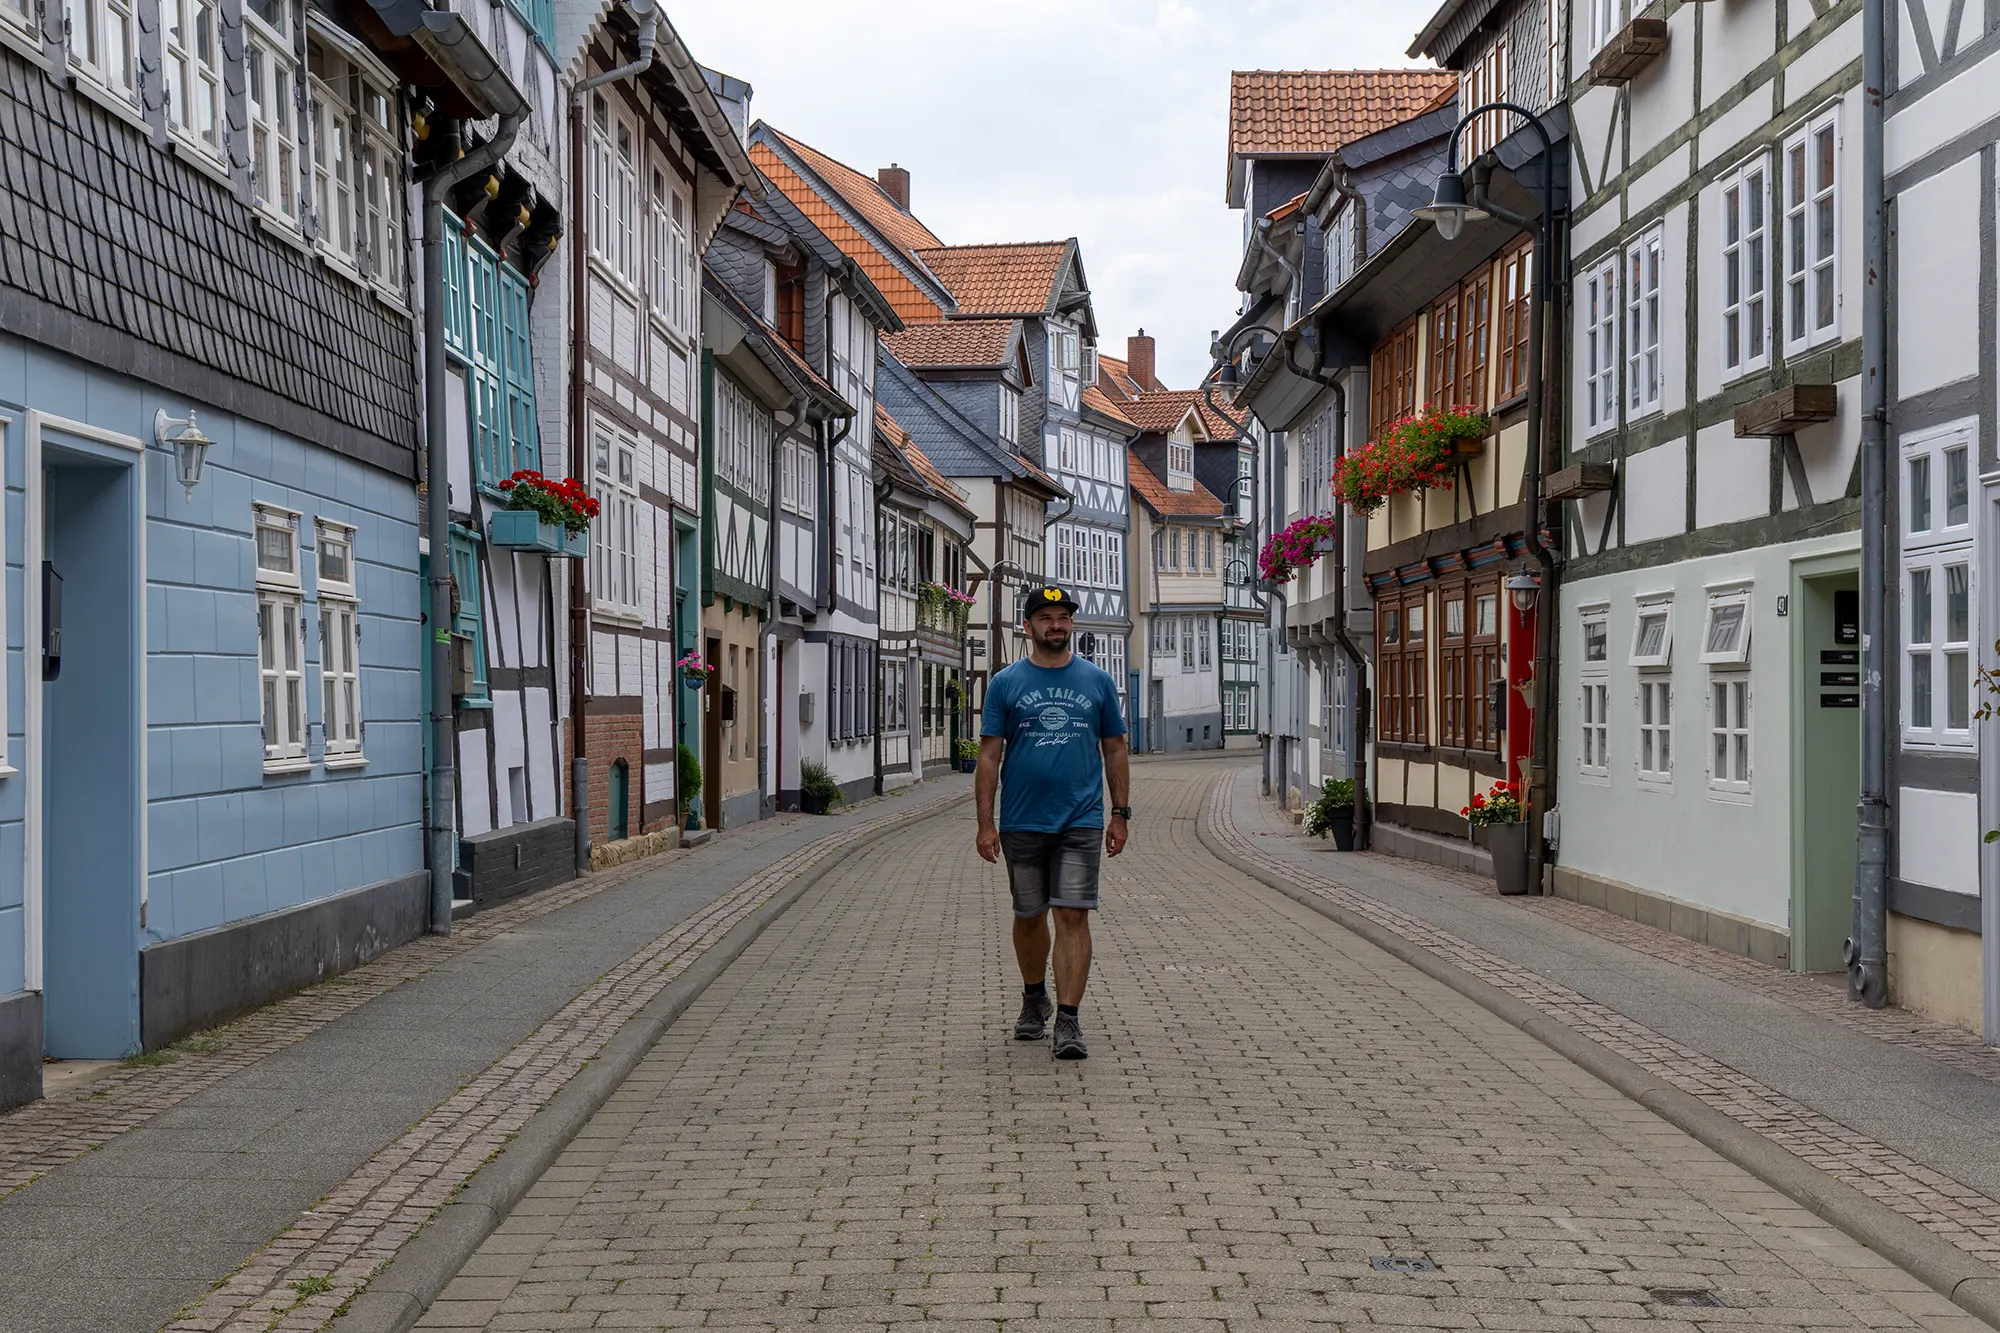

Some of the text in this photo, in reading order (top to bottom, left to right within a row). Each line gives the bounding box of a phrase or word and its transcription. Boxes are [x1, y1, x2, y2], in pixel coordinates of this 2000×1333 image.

[50, 627, 62, 654] 17
[1015, 687, 1093, 710] TOM TAILOR
